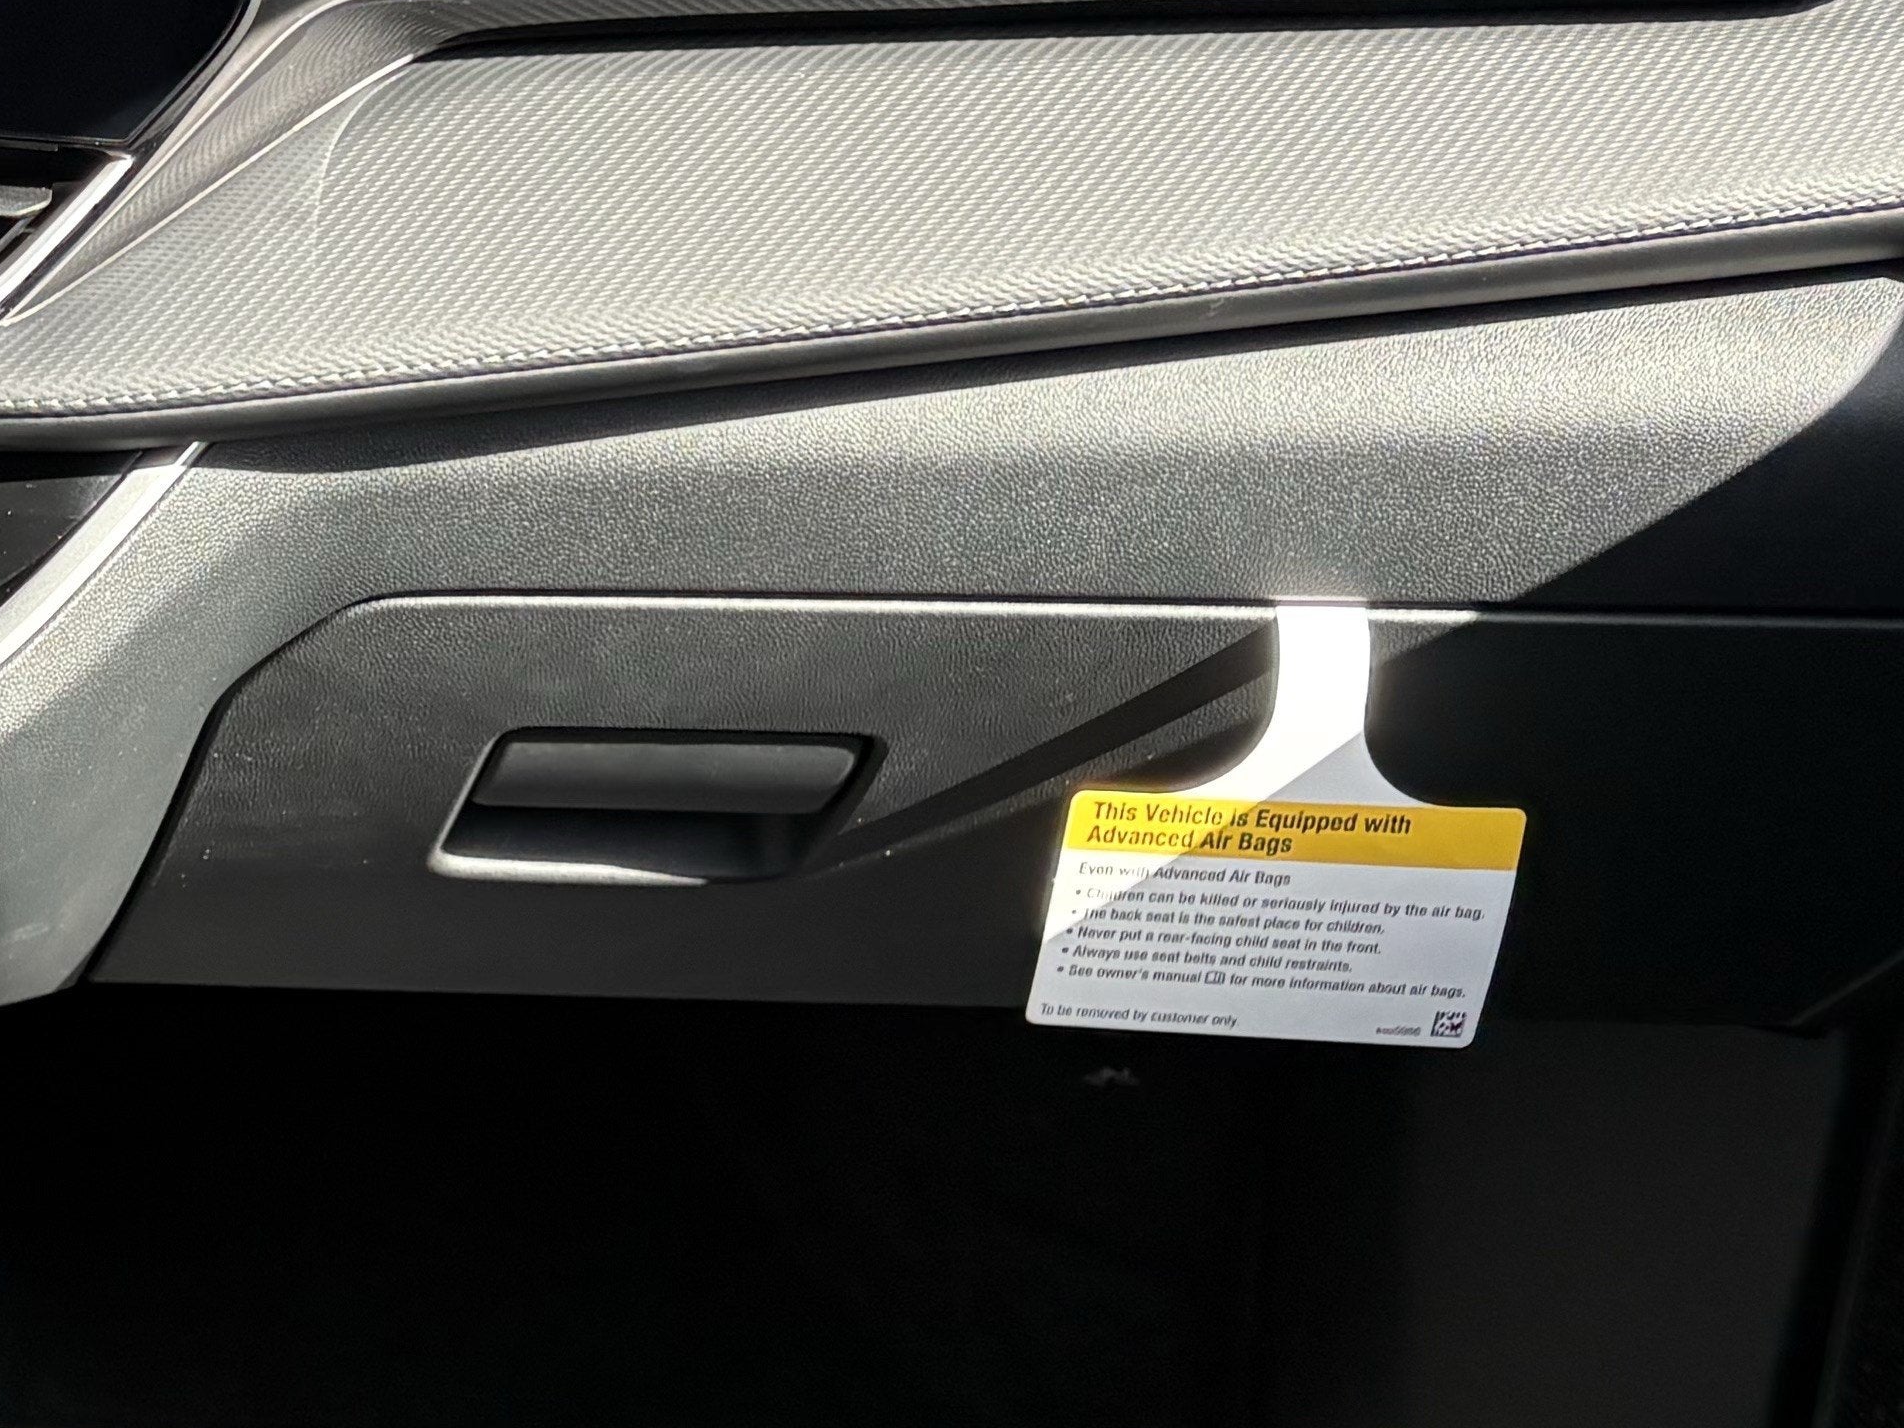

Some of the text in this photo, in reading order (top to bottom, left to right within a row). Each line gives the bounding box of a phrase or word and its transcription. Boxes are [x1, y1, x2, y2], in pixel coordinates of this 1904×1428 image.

[1094, 802, 1412, 834] This Vehicle is Equipped with
[1087, 825, 1293, 855] Advanced Air Bags
[1079, 862, 1113, 875] Even
[1153, 866, 1225, 882] Advanced
[1229, 869, 1251, 883] Air
[1255, 870, 1291, 888] Bags
[1148, 892, 1174, 903] can
[1179, 891, 1195, 904] be
[1200, 893, 1239, 906] killed
[1243, 897, 1258, 908] or
[1261, 898, 1326, 913] seriously
[1330, 899, 1379, 914] injured
[1384, 903, 1401, 917] by
[1405, 904, 1427, 917] the
[1432, 906, 1451, 918] air
[1111, 909, 1142, 921] back
[1146, 911, 1175, 922] seat
[1179, 912, 1190, 923] is
[1194, 913, 1215, 925] the
[1219, 915, 1260, 929] safest
[1263, 918, 1300, 931] place
[1304, 920, 1322, 932] for
[1077, 926, 1116, 939] Never
[1119, 930, 1142, 942] put
[1157, 931, 1231, 948] rear-facing
[1235, 936, 1268, 948] child
[1272, 938, 1300, 950] seat
[1304, 939, 1317, 951] in
[1321, 940, 1343, 952] the
[1073, 945, 1120, 961] Always
[1124, 950, 1148, 960] use
[1151, 951, 1180, 963] seat
[1184, 952, 1215, 965] belts
[1219, 953, 1246, 966] and
[1249, 956, 1282, 969] child
[1069, 964, 1093, 977] See
[1153, 971, 1201, 983] manual
[1230, 973, 1247, 985] for
[1251, 977, 1285, 989] more
[1289, 977, 1365, 992] information
[1368, 983, 1407, 995] about
[1410, 984, 1428, 996] air
[1041, 1003, 1054, 1015] To
[1057, 1005, 1073, 1016] be
[1076, 1007, 1130, 1021] removed
[1133, 1010, 1147, 1022] by
[1151, 1011, 1208, 1024] customer
